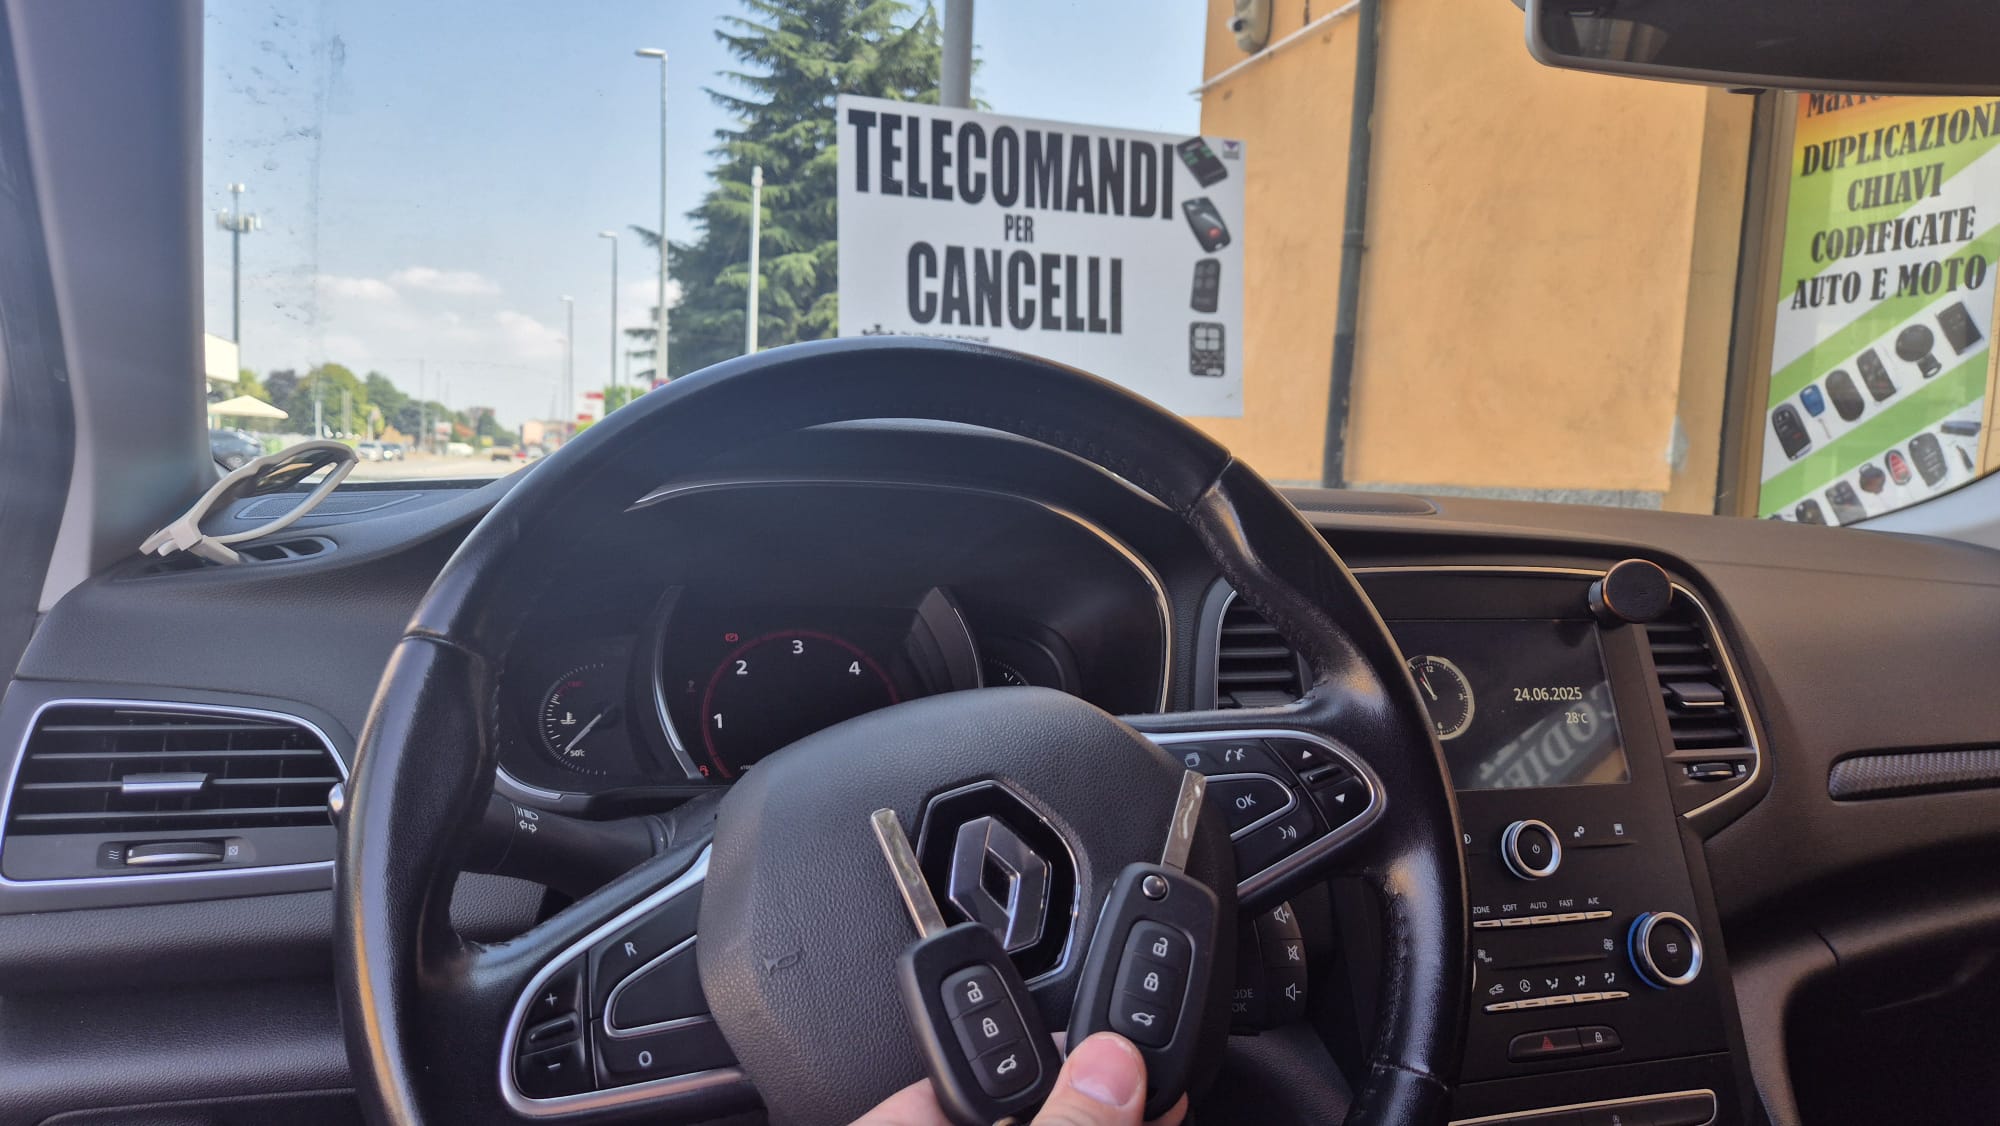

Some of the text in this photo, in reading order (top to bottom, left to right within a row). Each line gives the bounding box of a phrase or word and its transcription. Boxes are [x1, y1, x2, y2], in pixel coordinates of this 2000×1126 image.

[848, 108, 1174, 220] TELECOMANDI
[1847, 162, 1944, 212] CHIAVI
[1004, 214, 1034, 243] PER
[1811, 206, 1976, 264] CODIFICATE
[907, 241, 1123, 335] CANCELLI
[1790, 254, 1987, 311] AUTO E MOTO
[792, 640, 804, 654] 3
[736, 660, 748, 675] 2
[849, 661, 861, 675] 4
[1513, 686, 1583, 702] 24.06.2025
[713, 713, 723, 729] 1
[1565, 712, 1588, 724] 28°C
[1236, 793, 1256, 809] OK
[1473, 906, 1491, 914] ZONE
[1502, 904, 1517, 912] SOFT
[1530, 902, 1547, 910] AUTO
[1559, 899, 1573, 907] FAST
[624, 942, 637, 956] R
[1232, 988, 1254, 999] ODE
